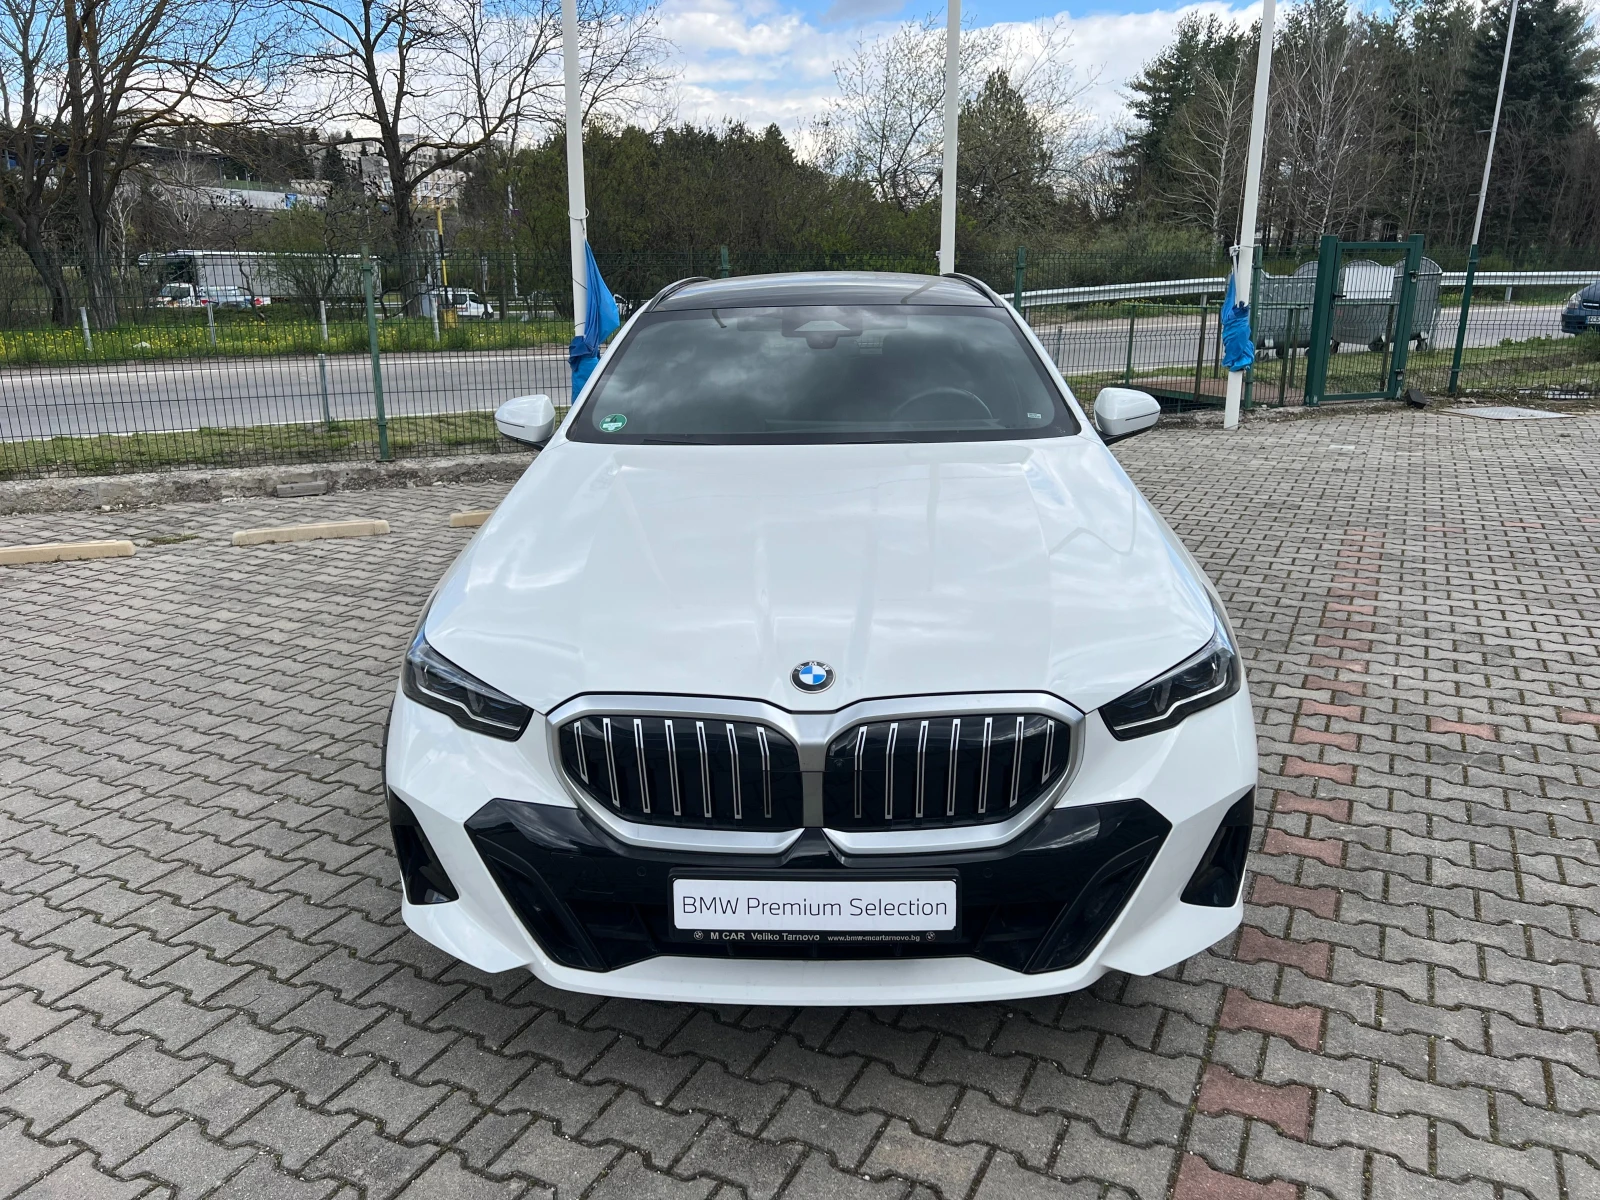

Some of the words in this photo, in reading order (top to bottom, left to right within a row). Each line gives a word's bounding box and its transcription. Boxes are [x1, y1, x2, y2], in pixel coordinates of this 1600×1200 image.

[682, 896, 739, 915] BMW
[747, 897, 842, 916] Premium
[849, 898, 948, 917] Selection
[710, 932, 719, 940] M
[722, 932, 745, 940] CAR
[751, 932, 780, 941] Veliko
[782, 932, 820, 941] Tarnovo
[827, 934, 921, 942] www.bmw-mcartarnovo.bg
